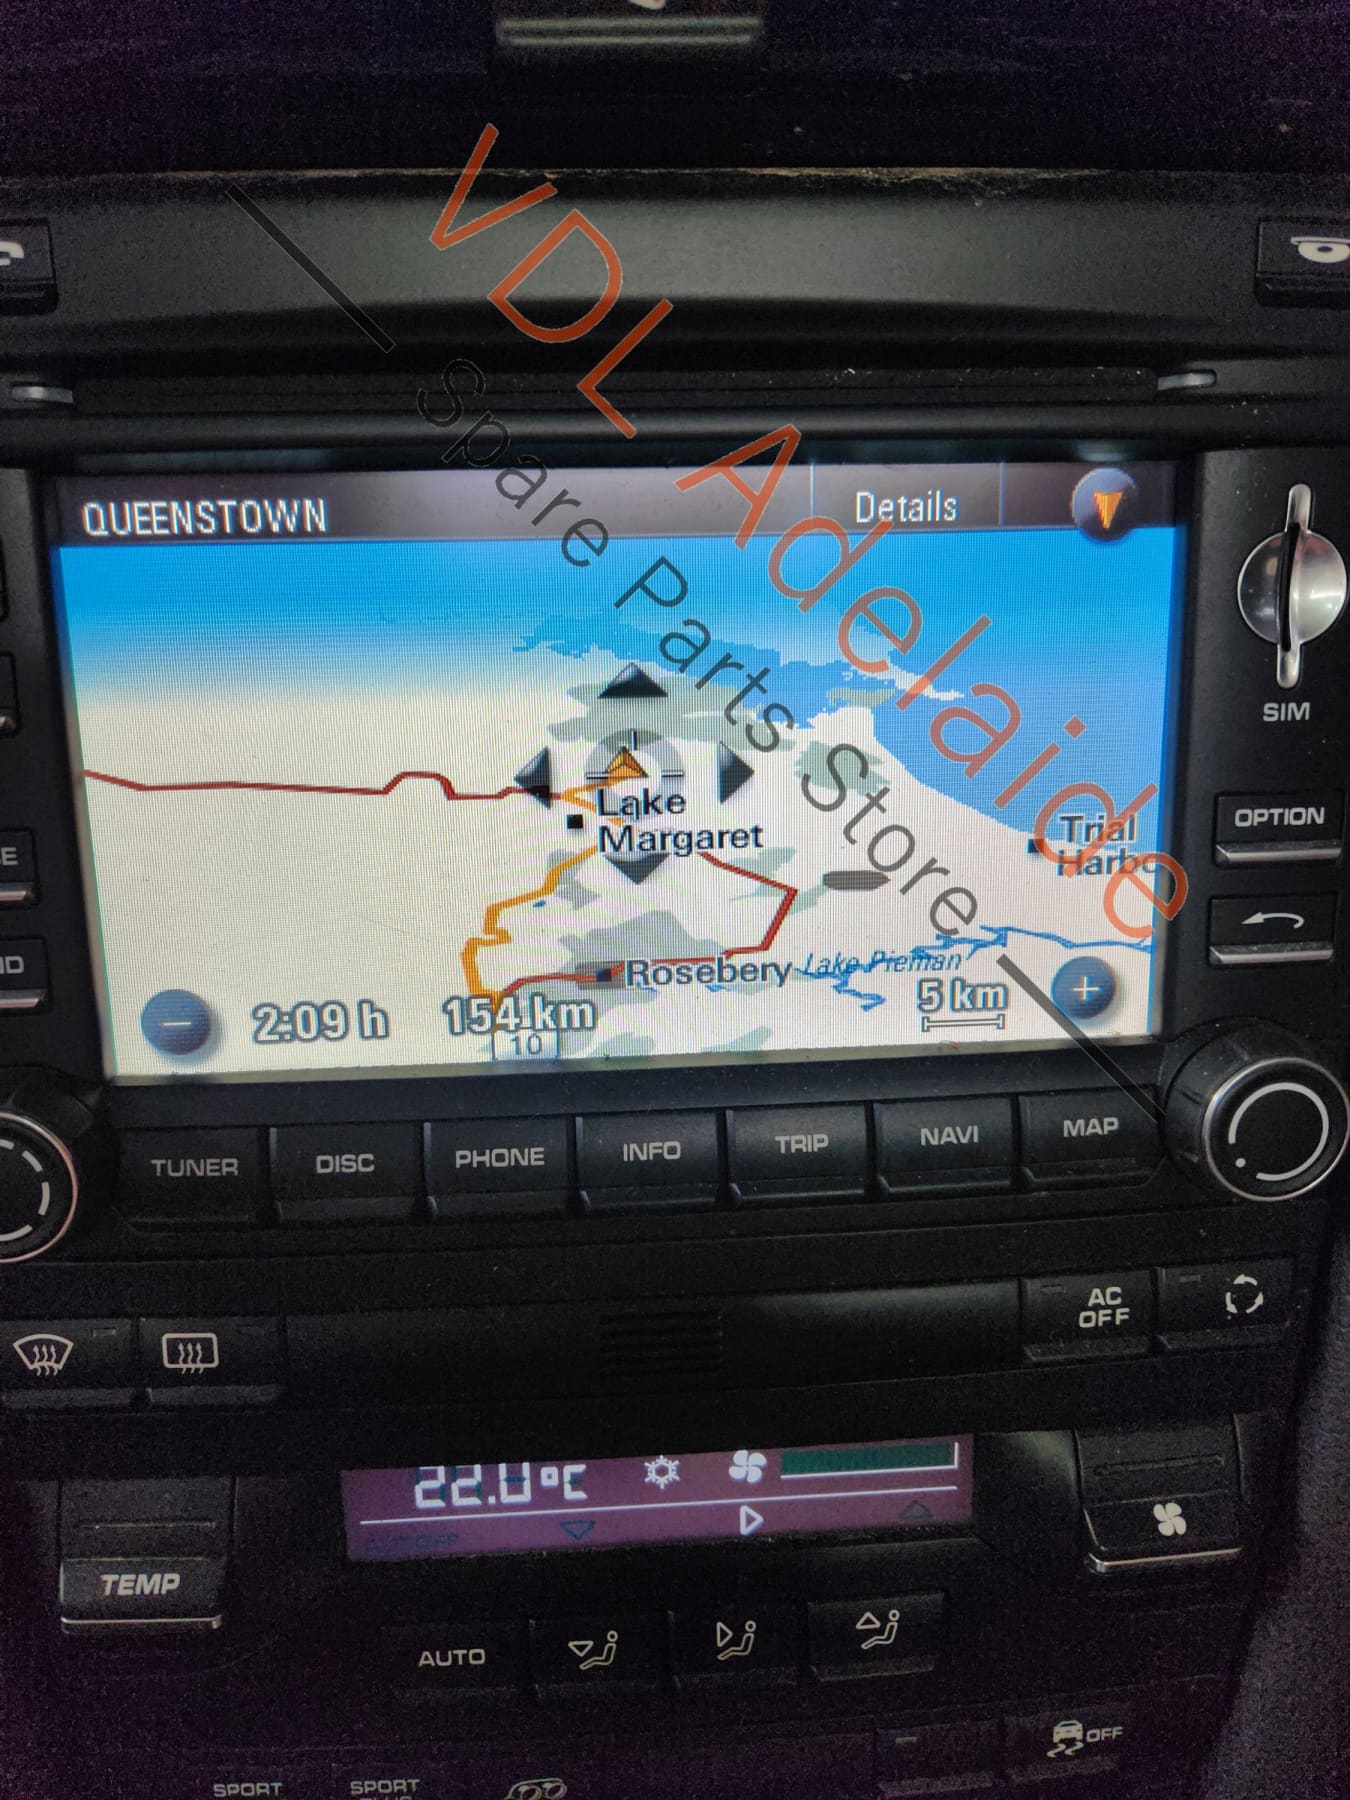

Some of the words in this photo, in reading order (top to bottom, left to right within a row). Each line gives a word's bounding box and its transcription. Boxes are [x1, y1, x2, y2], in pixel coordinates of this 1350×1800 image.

[82, 497, 328, 537] QUEENSTOWN
[855, 489, 958, 523] Details
[1262, 701, 1311, 722] SIM
[597, 786, 686, 820] Lake
[1059, 812, 1136, 843] Trial
[1234, 807, 1325, 828] OPTION
[597, 823, 764, 857] Margaret
[626, 957, 793, 988] Rosebery
[804, 952, 860, 976] Lake
[871, 948, 963, 974] Pieman
[916, 978, 944, 1013] 5
[950, 978, 1009, 1012] km
[252, 1001, 350, 1045] 2:09
[358, 998, 390, 1040] h
[442, 996, 520, 1036] 154
[530, 992, 597, 1032] km
[511, 1034, 544, 1055] 10
[919, 1125, 980, 1146] NAVI
[1062, 1116, 1119, 1139] MAP
[622, 1140, 682, 1162] INFO
[774, 1133, 830, 1155] TRIP
[150, 1156, 240, 1178] TUNER
[316, 1153, 376, 1174] DISC
[455, 1146, 546, 1169] PHONE
[1087, 1286, 1123, 1307] AC
[1078, 1307, 1131, 1329] OFF
[101, 1572, 181, 1597] TEMP
[418, 1648, 487, 1668] AUTO
[1086, 1726, 1124, 1743] OFF
[213, 1782, 283, 1798] SPORT
[350, 1778, 421, 1795] SPORT
